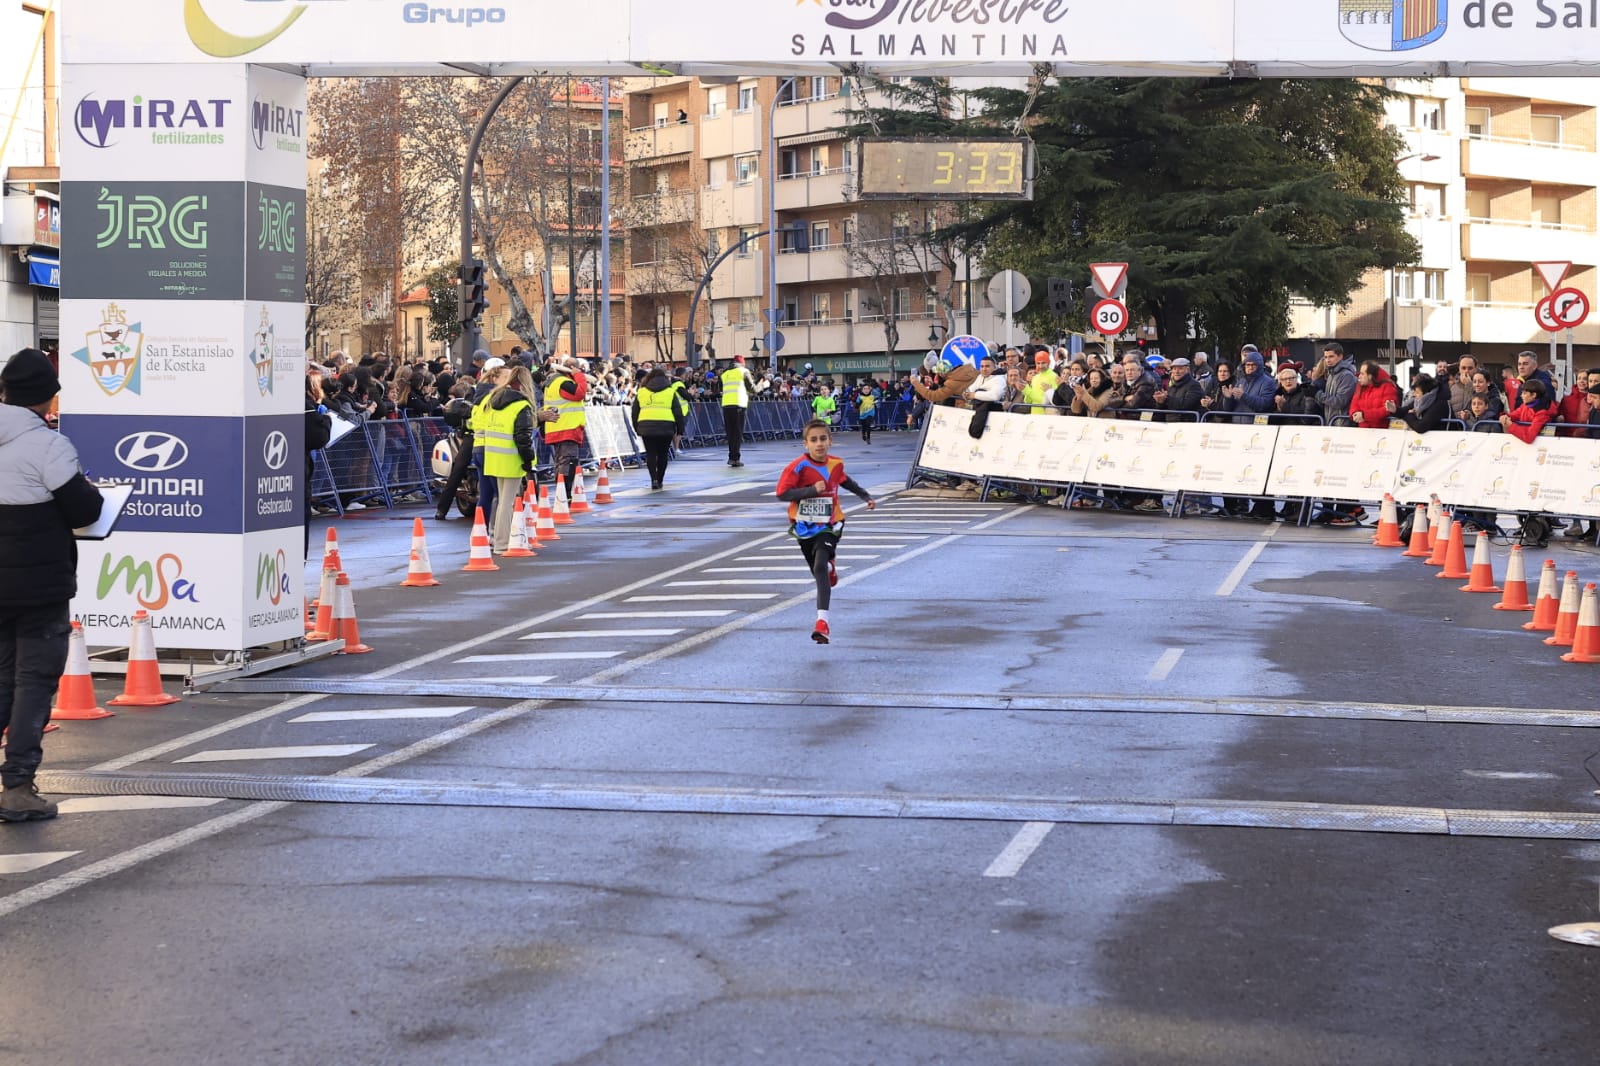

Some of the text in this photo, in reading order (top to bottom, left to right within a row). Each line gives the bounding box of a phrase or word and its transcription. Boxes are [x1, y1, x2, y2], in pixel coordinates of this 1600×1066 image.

[402, 3, 506, 27] Grupo
[1463, 0, 1514, 28] de
[791, 34, 1068, 56] SALMANTINA
[152, 131, 224, 144] fertilizantes
[169, 261, 207, 269] SOLUCIONES
[1100, 311, 1120, 323] 30
[146, 344, 234, 358] San Estanislao
[146, 358, 206, 372] de Kostka
[257, 475, 293, 494] HYUNDAI
[257, 496, 293, 516] Gestorauto
[802, 503, 826, 515] 5930
